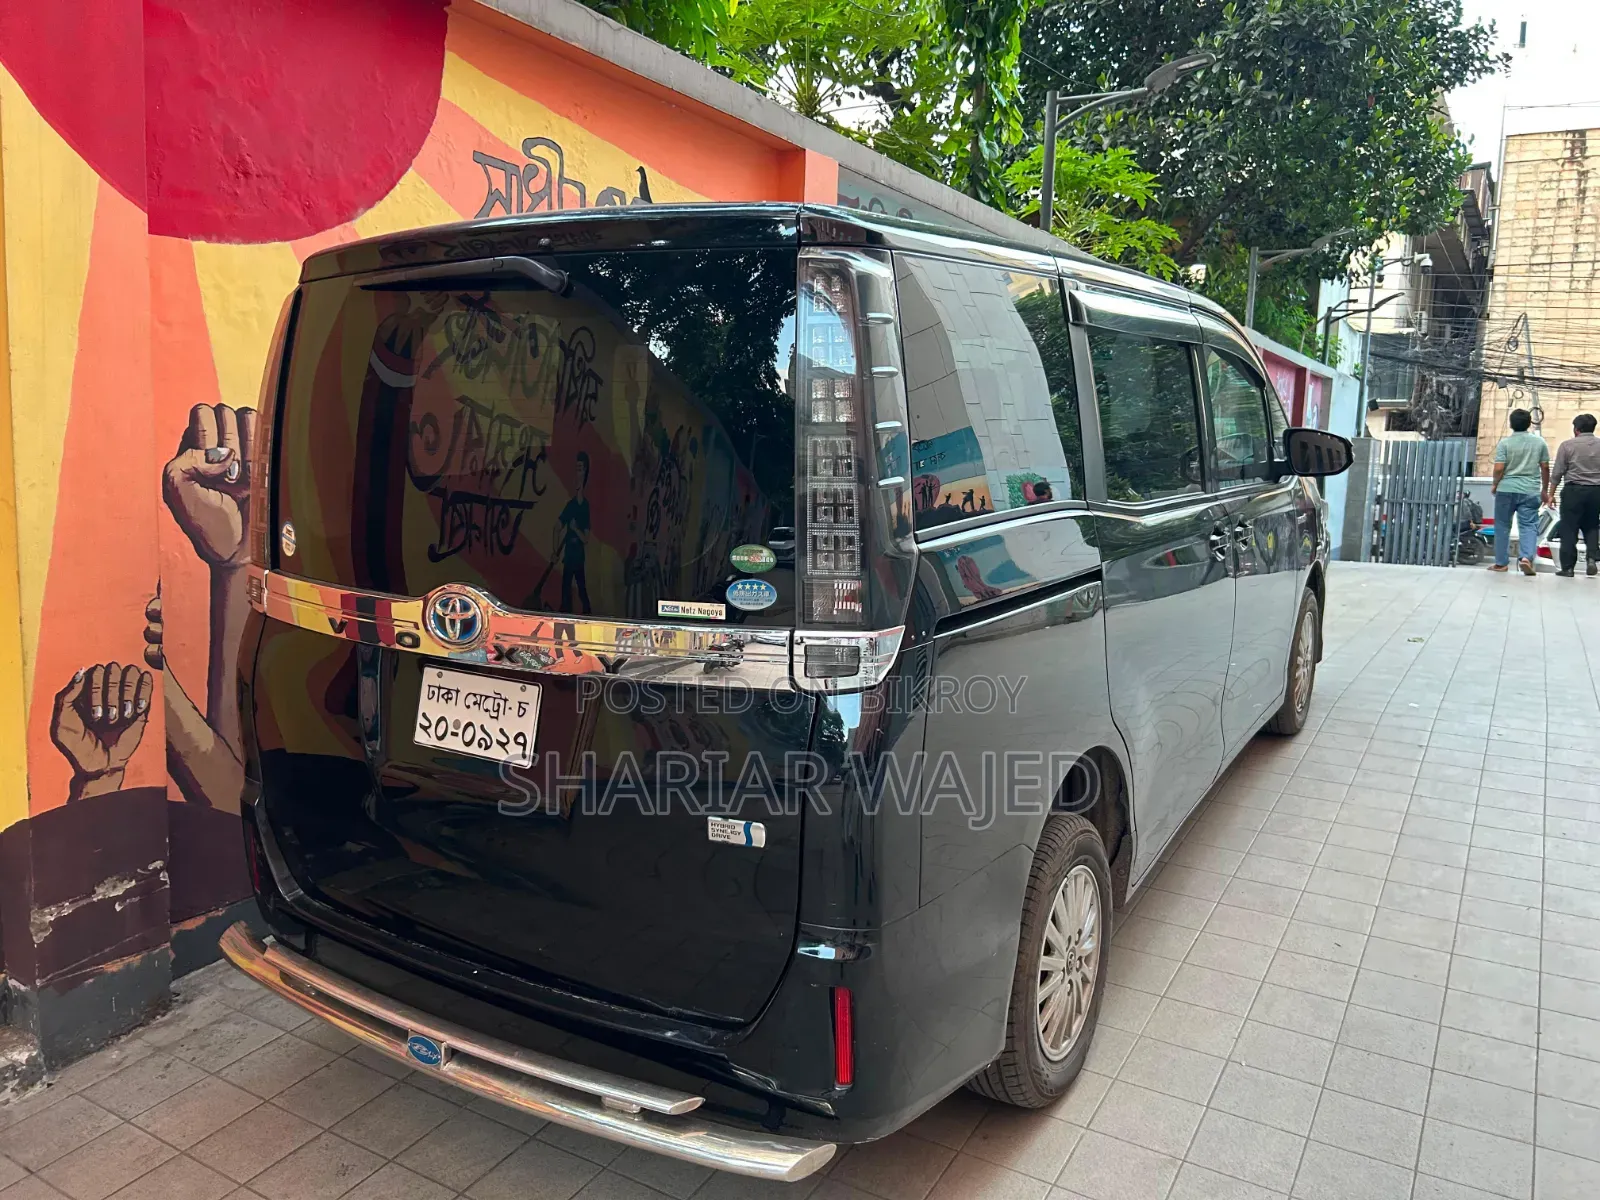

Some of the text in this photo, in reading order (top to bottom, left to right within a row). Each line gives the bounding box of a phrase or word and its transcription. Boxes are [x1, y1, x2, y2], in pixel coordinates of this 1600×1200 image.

[681, 606, 696, 615] Netz
[697, 607, 723, 617] Nagoya
[427, 684, 460, 706] ঢাকা
[419, 711, 528, 760] ২০-০৯২৭
